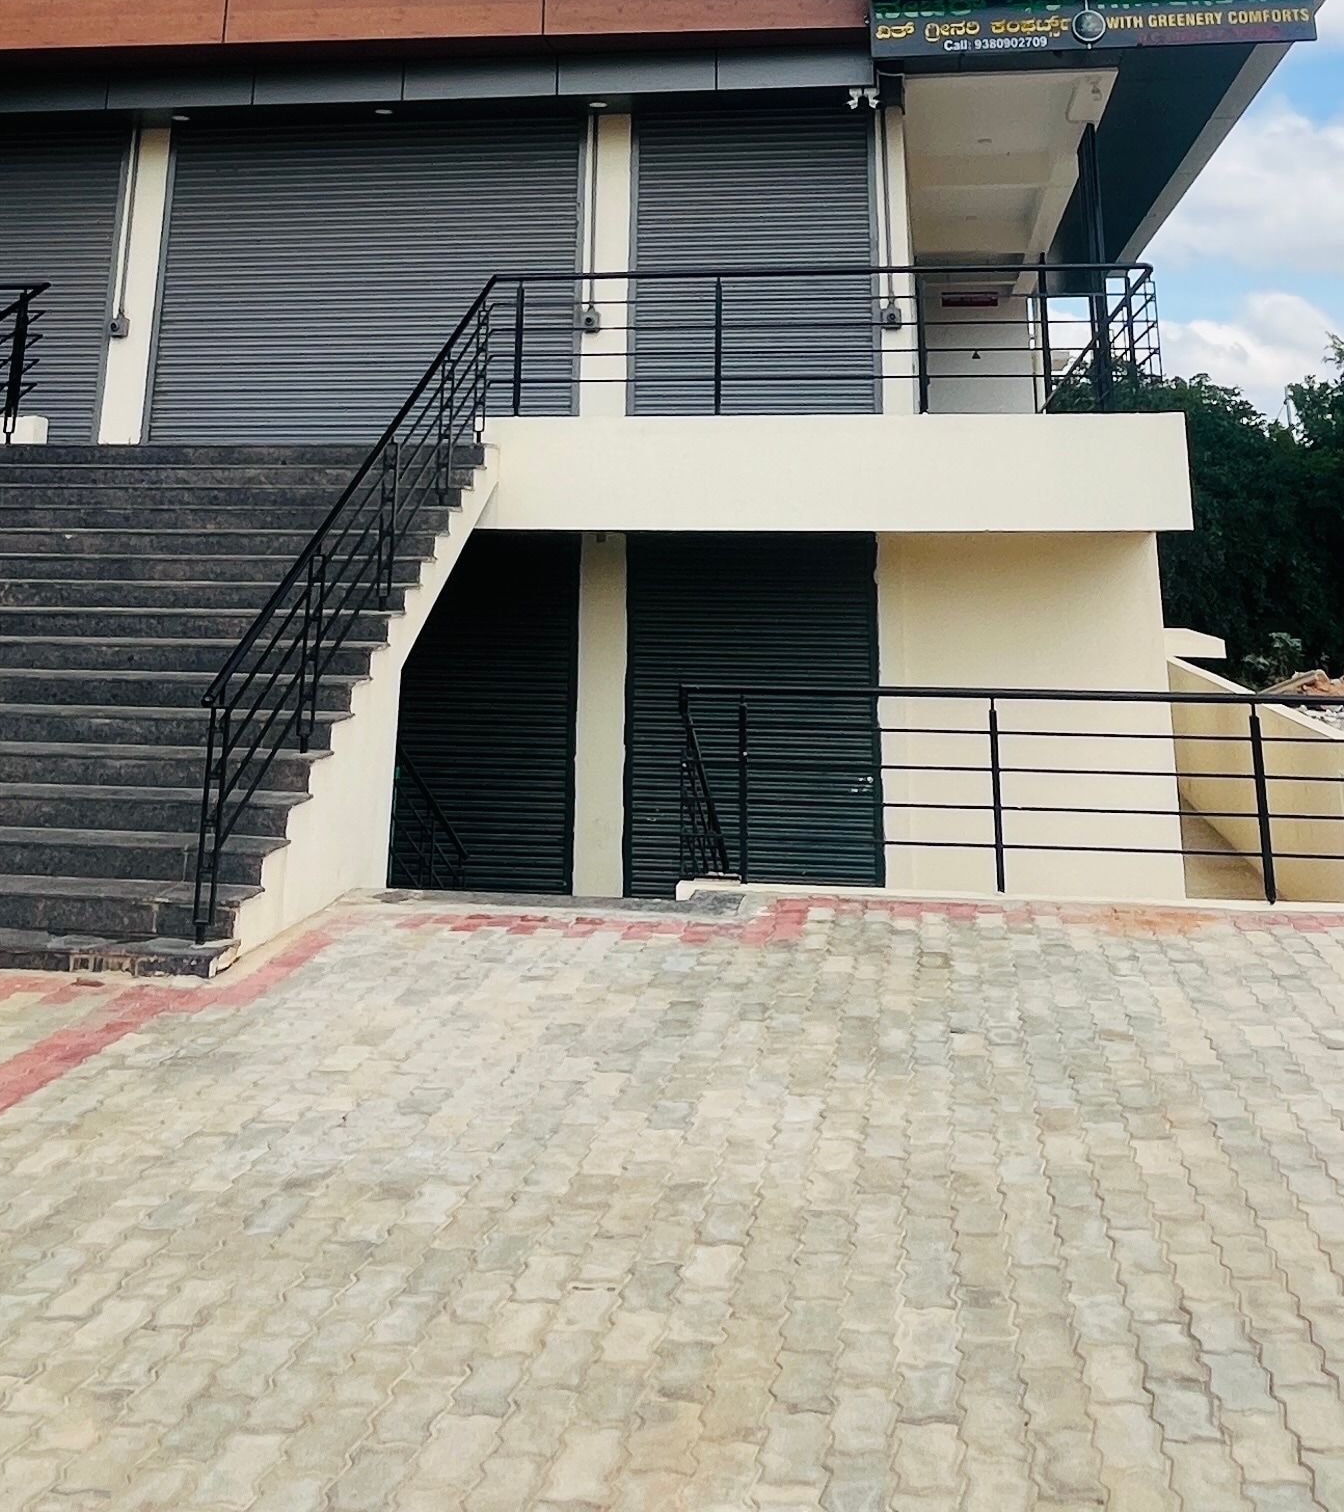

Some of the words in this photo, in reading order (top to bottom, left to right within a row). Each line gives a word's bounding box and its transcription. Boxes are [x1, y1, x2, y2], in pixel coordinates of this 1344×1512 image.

[1107, 15, 1143, 30] WITH
[1148, 11, 1223, 27] GREENERY
[1228, 8, 1310, 24] COMFORTS
[943, 39, 971, 51] Call:
[974, 37, 1048, 49] 9380902709
